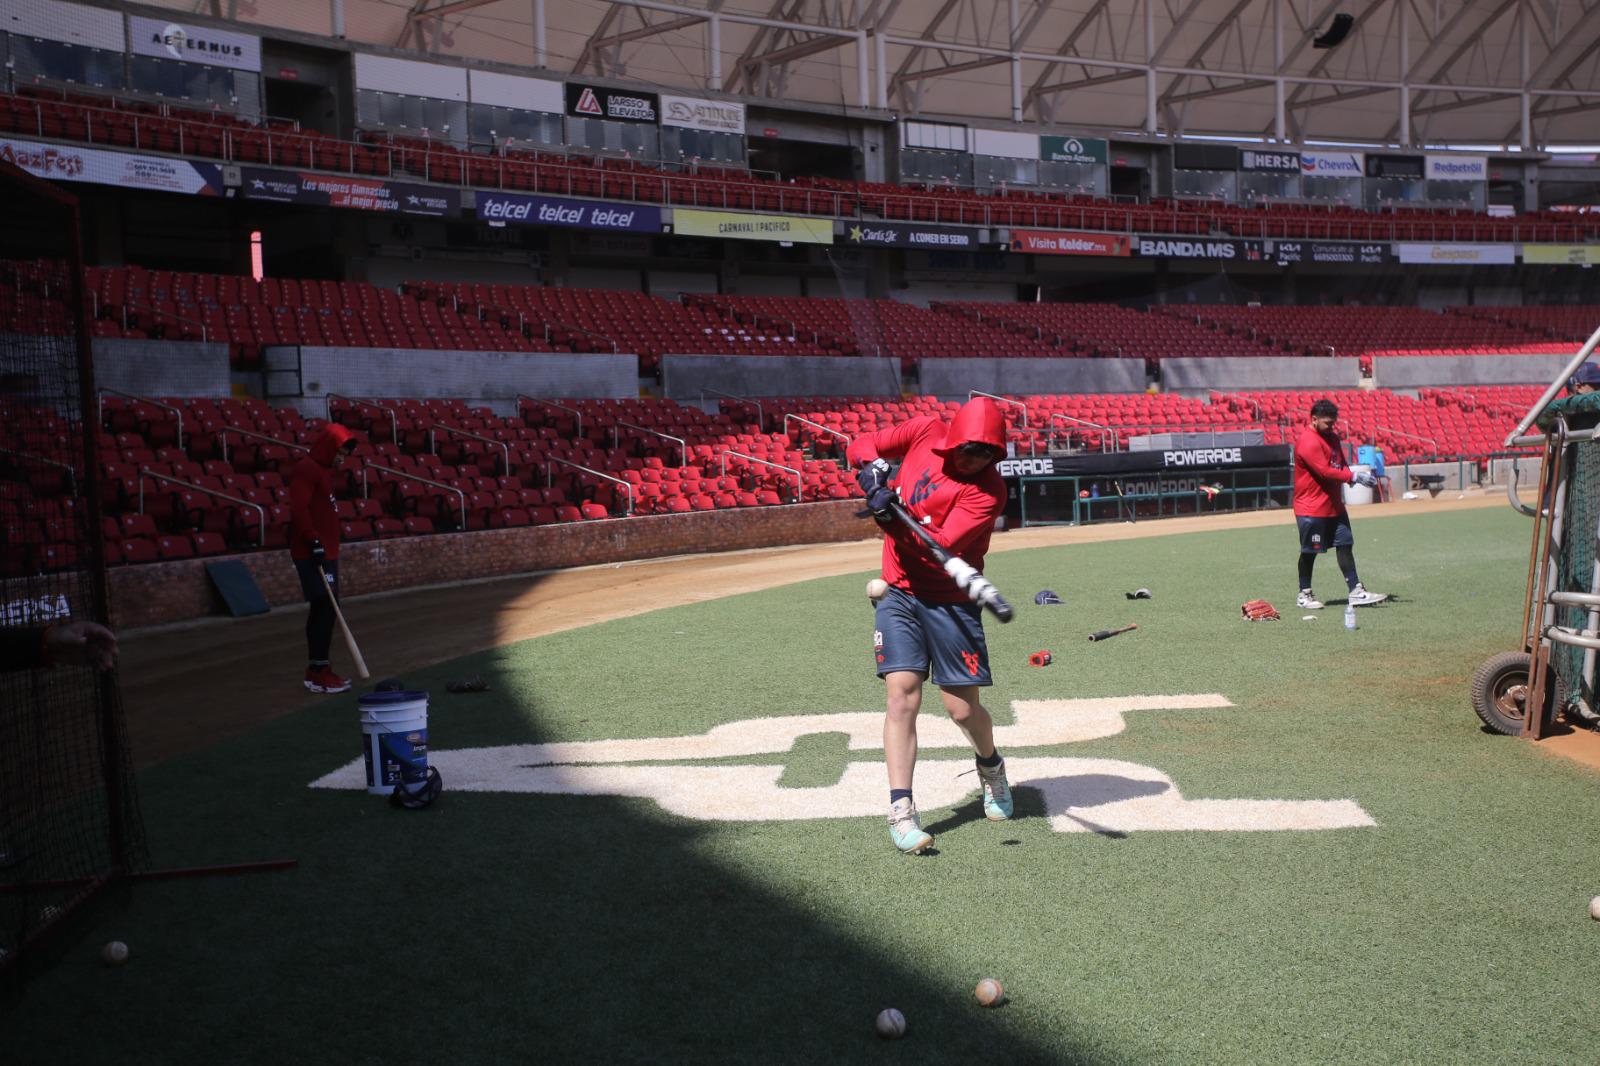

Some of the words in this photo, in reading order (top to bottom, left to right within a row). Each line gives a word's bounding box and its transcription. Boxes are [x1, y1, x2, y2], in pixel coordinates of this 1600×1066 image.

[608, 106, 655, 120] ELEVATOR
[1052, 152, 1073, 162] Banco
[1073, 154, 1097, 163] Azteca
[1255, 154, 1299, 168] HERSA
[302, 179, 316, 190] Los
[318, 182, 350, 194] mejores
[352, 197, 374, 209] mejor
[375, 199, 399, 210] precio
[484, 199, 532, 219] telcel
[539, 204, 585, 223] telcel
[591, 209, 635, 227] telcel
[719, 222, 754, 233] CARNAVAL
[909, 232, 915, 243] A
[916, 232, 939, 244] COMER
[940, 234, 949, 244] EN
[950, 234, 969, 245] SERIO
[1028, 236, 1056, 249] Visita
[1140, 240, 1206, 258] BANDA
[1207, 242, 1236, 259] MS
[1164, 447, 1242, 467] POWERADE
